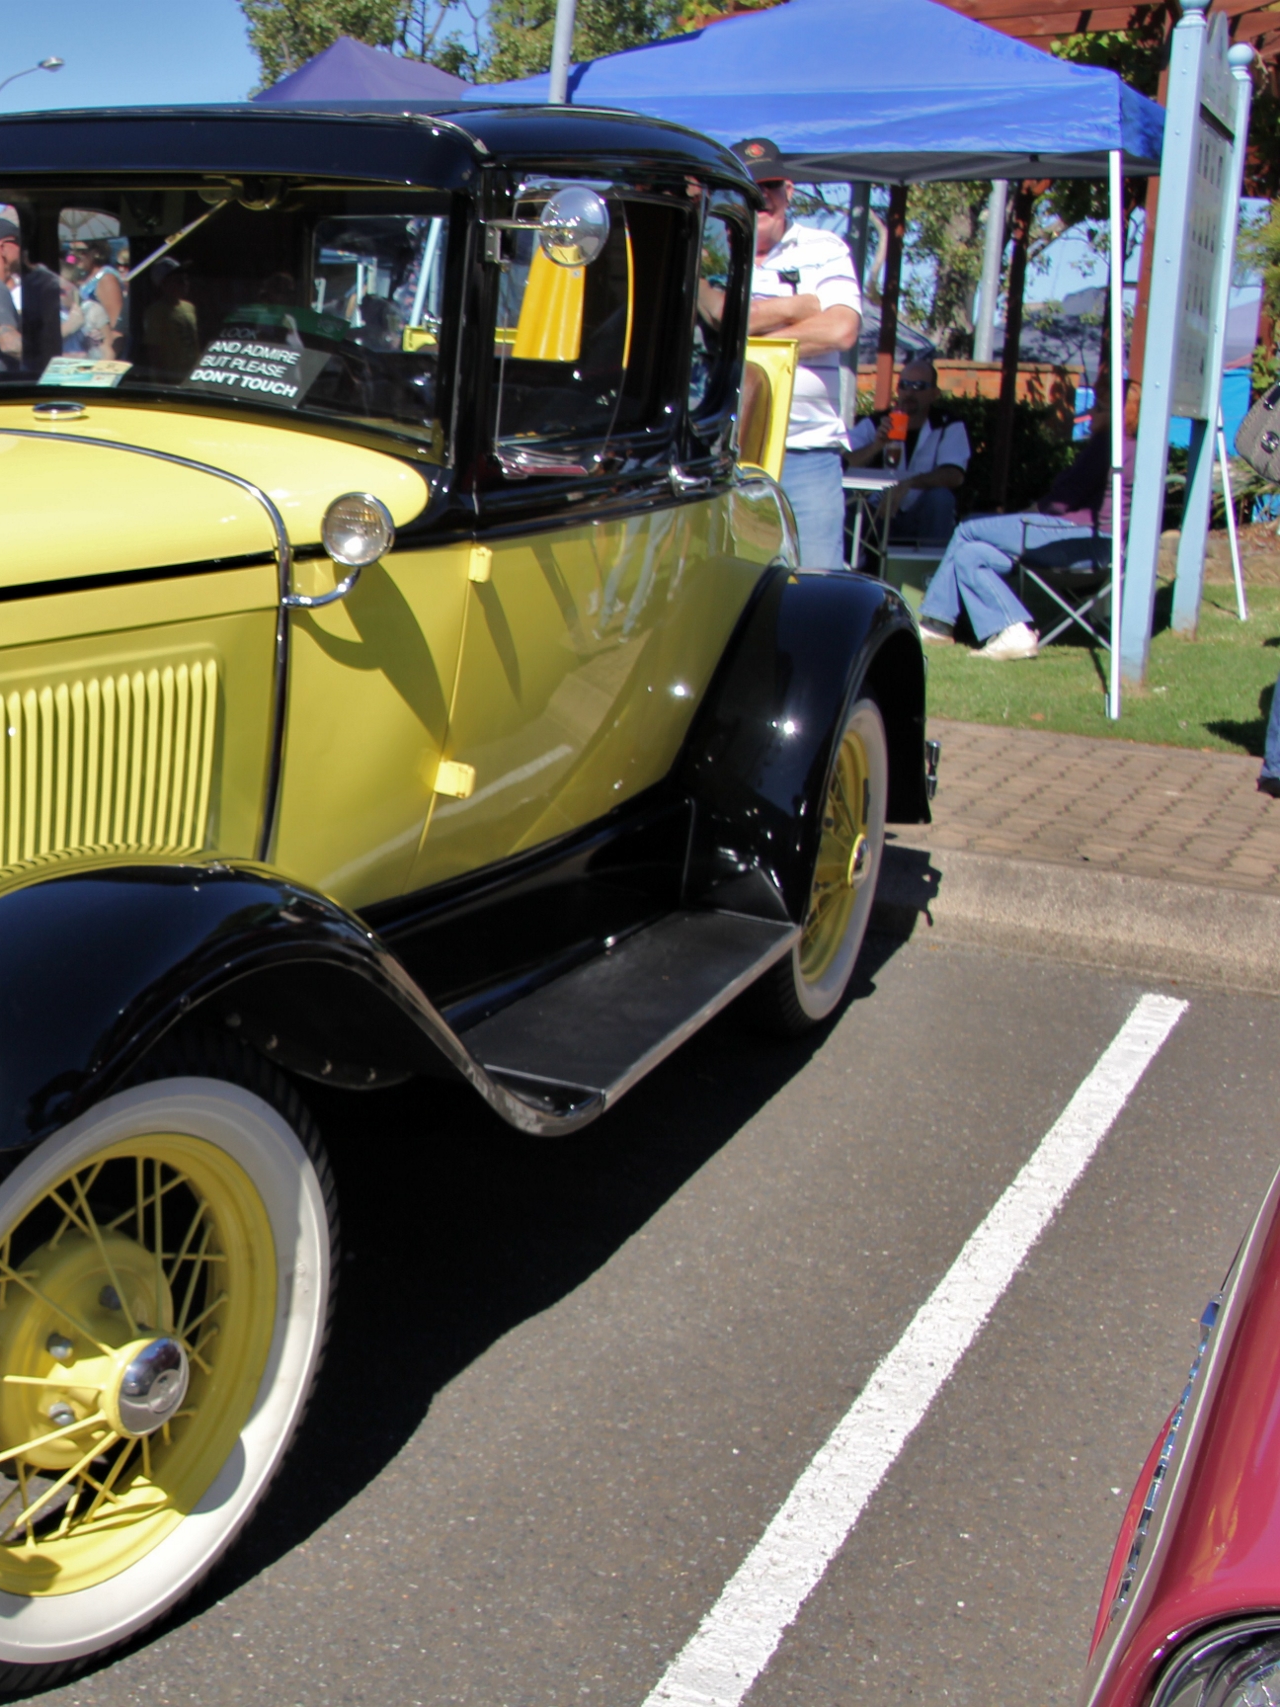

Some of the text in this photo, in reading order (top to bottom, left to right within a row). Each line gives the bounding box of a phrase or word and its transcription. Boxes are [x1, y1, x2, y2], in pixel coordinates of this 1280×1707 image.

[208, 341, 300, 364] AND ADMIRE
[200, 355, 287, 378] BUT PLEASE
[190, 369, 298, 397] DON'T TOUCH
